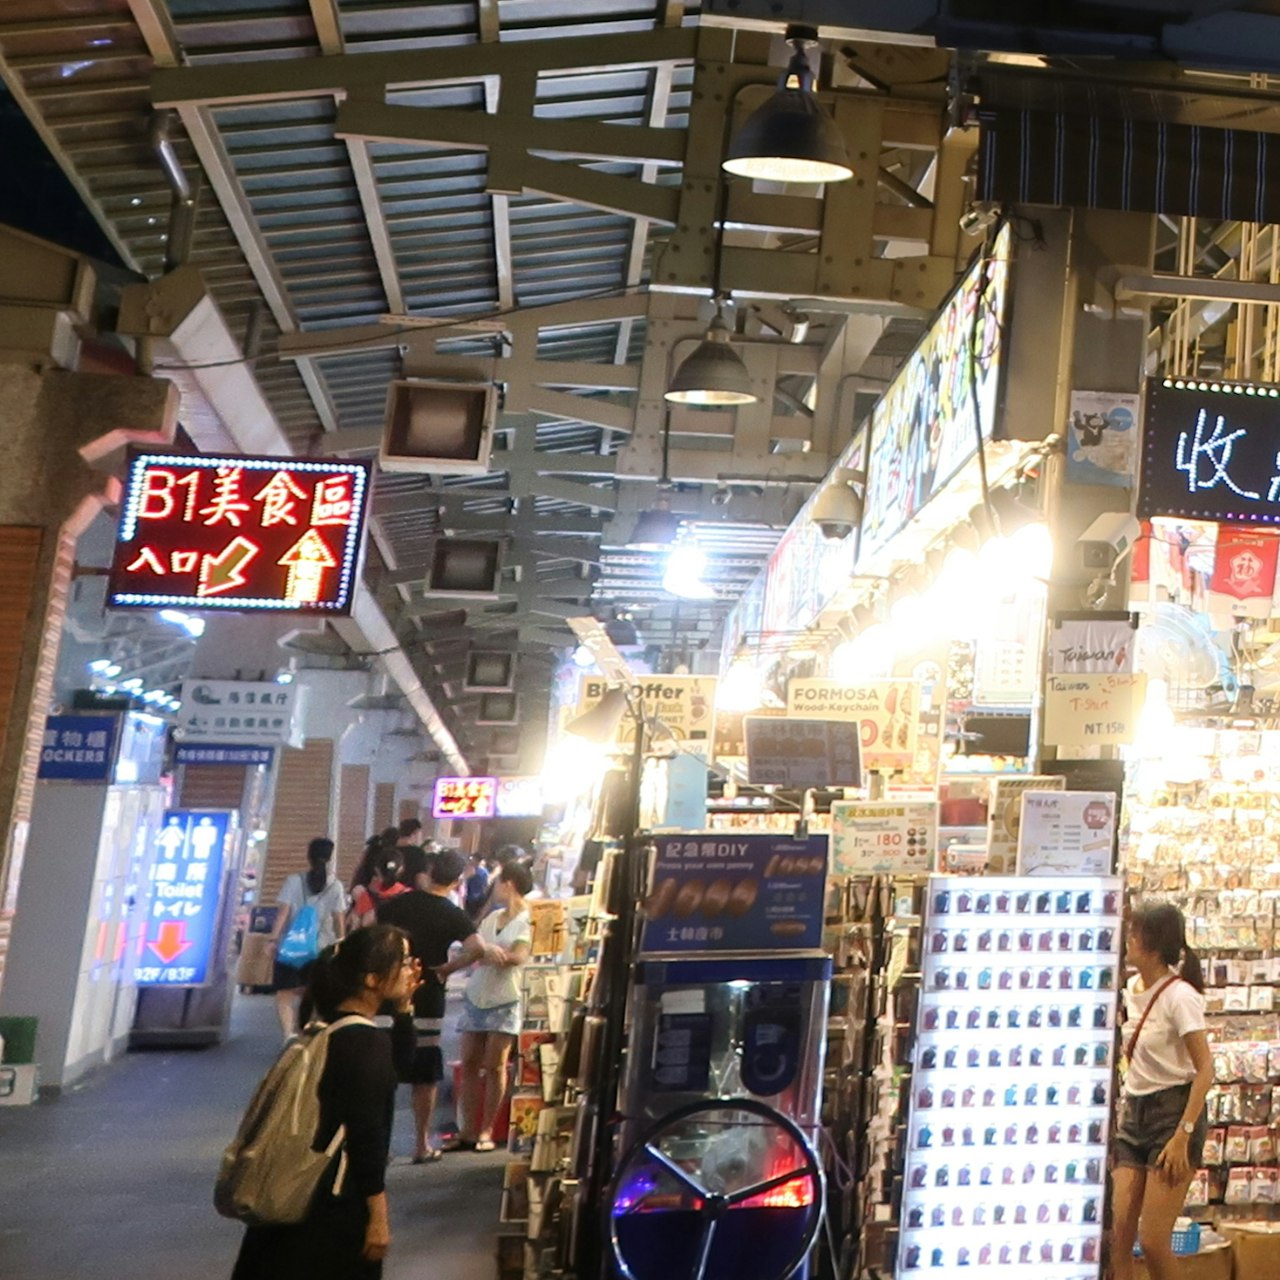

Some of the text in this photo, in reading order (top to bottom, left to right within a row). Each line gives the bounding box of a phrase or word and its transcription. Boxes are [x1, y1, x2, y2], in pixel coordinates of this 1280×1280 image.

[136, 467, 352, 527] B1美食區
[126, 546, 198, 575] 入口
[1058, 646, 1115, 664] Taiwan
[793, 687, 880, 701] FORMOSA
[793, 703, 880, 713] Wood-Keychain
[43, 749, 105, 763] OCKERS
[876, 833, 903, 847] 180
[155, 882, 204, 898] Toilet
[153, 900, 202, 918] トイレ
